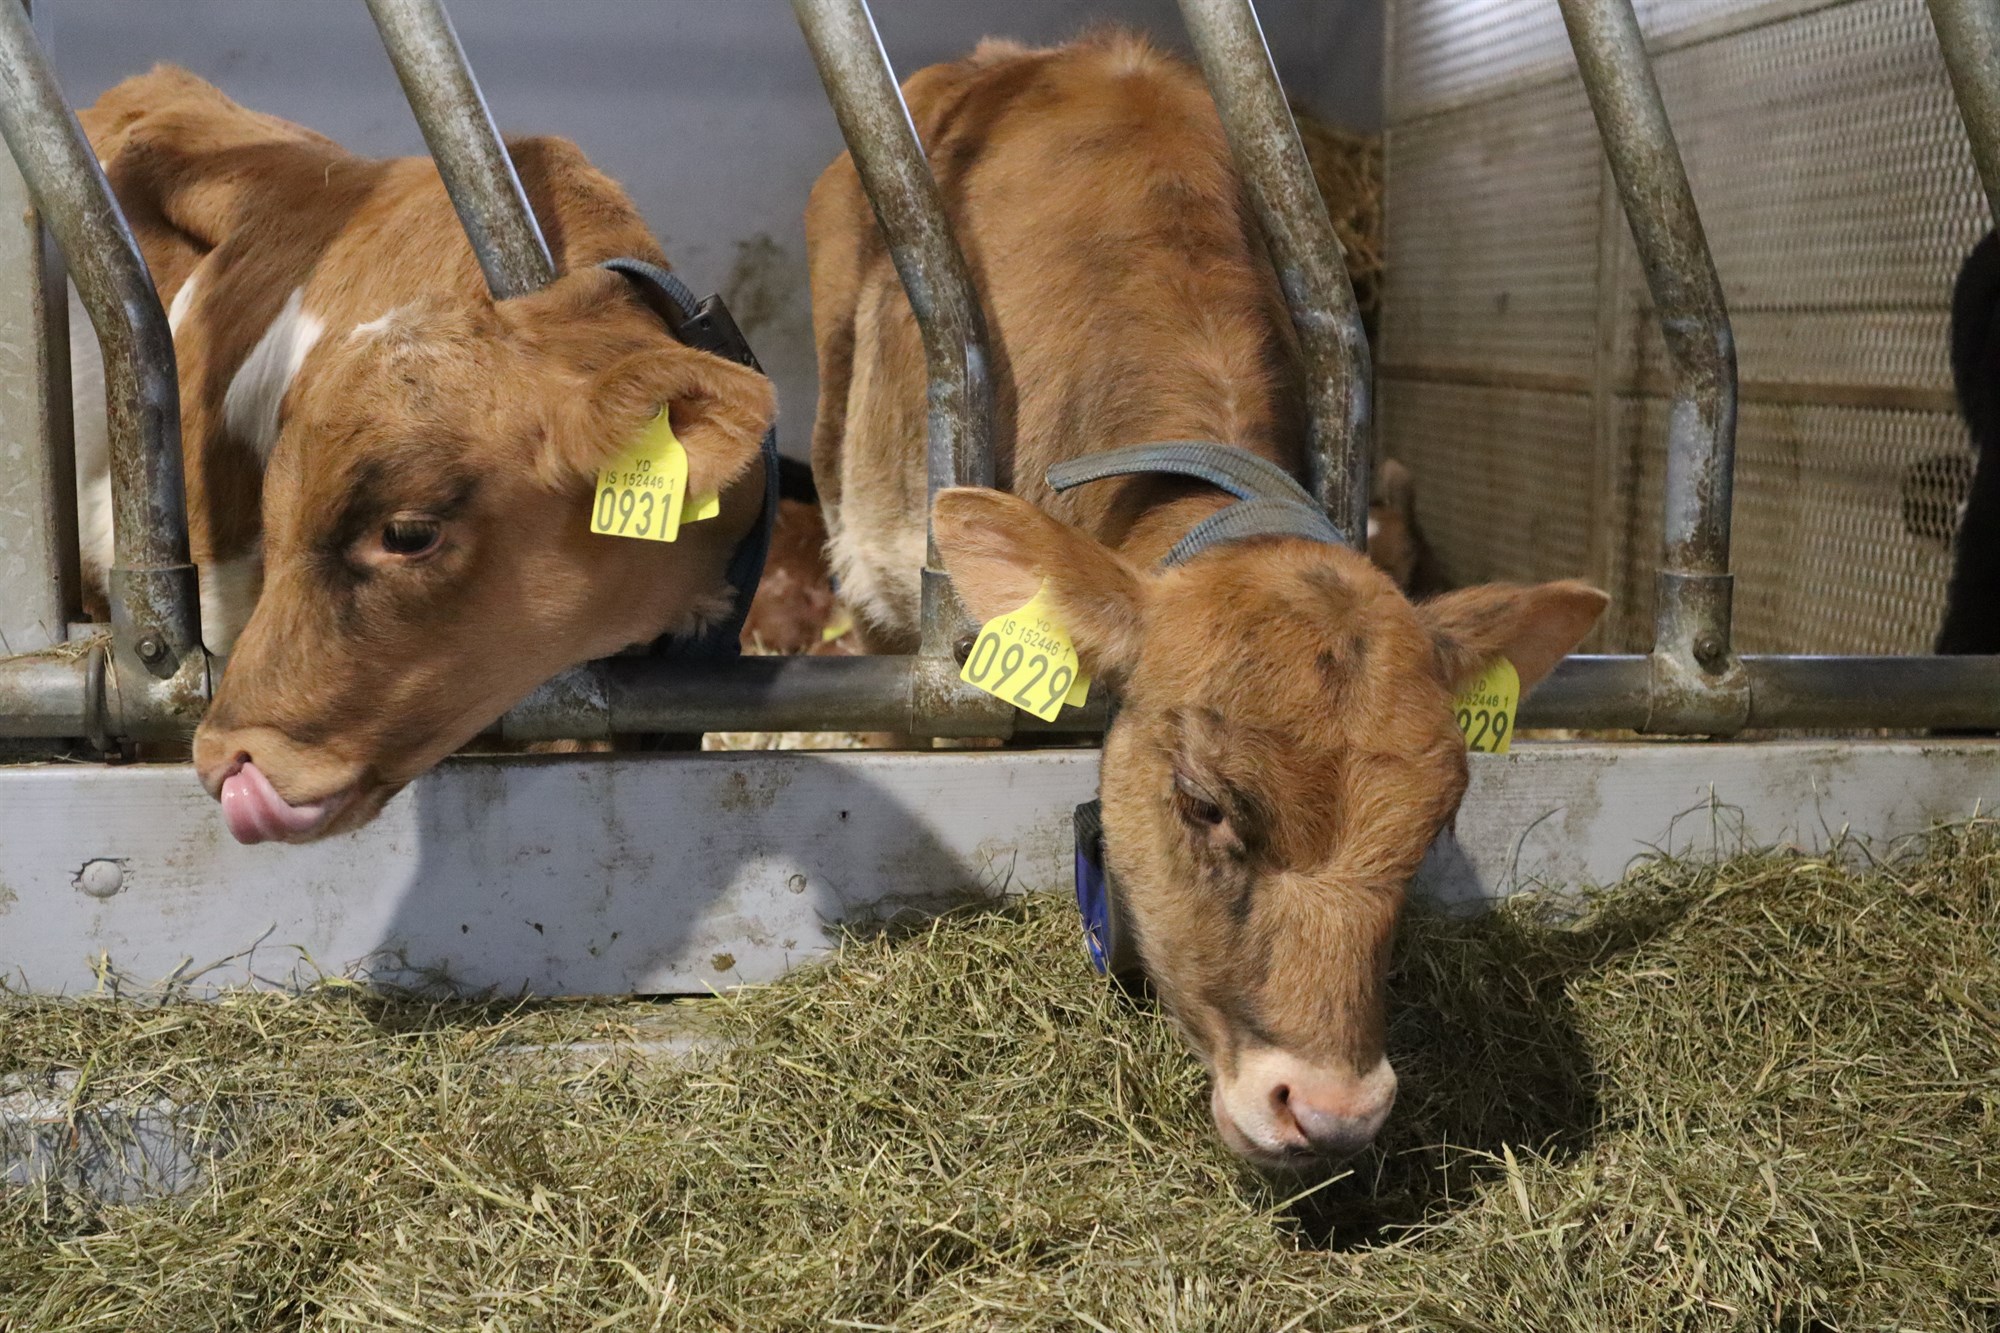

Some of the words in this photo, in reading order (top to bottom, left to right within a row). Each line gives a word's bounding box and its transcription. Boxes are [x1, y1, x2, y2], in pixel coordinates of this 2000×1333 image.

[605, 471, 617, 484] IS
[622, 472, 664, 489] 152446
[670, 478, 675, 490] 1
[635, 459, 651, 472] YD
[597, 486, 672, 539] 0931
[1001, 618, 1016, 635] IS
[1019, 627, 1060, 656] 152446
[1062, 647, 1071, 661] 1
[1036, 618, 1050, 632] YD
[968, 632, 1072, 714] 0929
